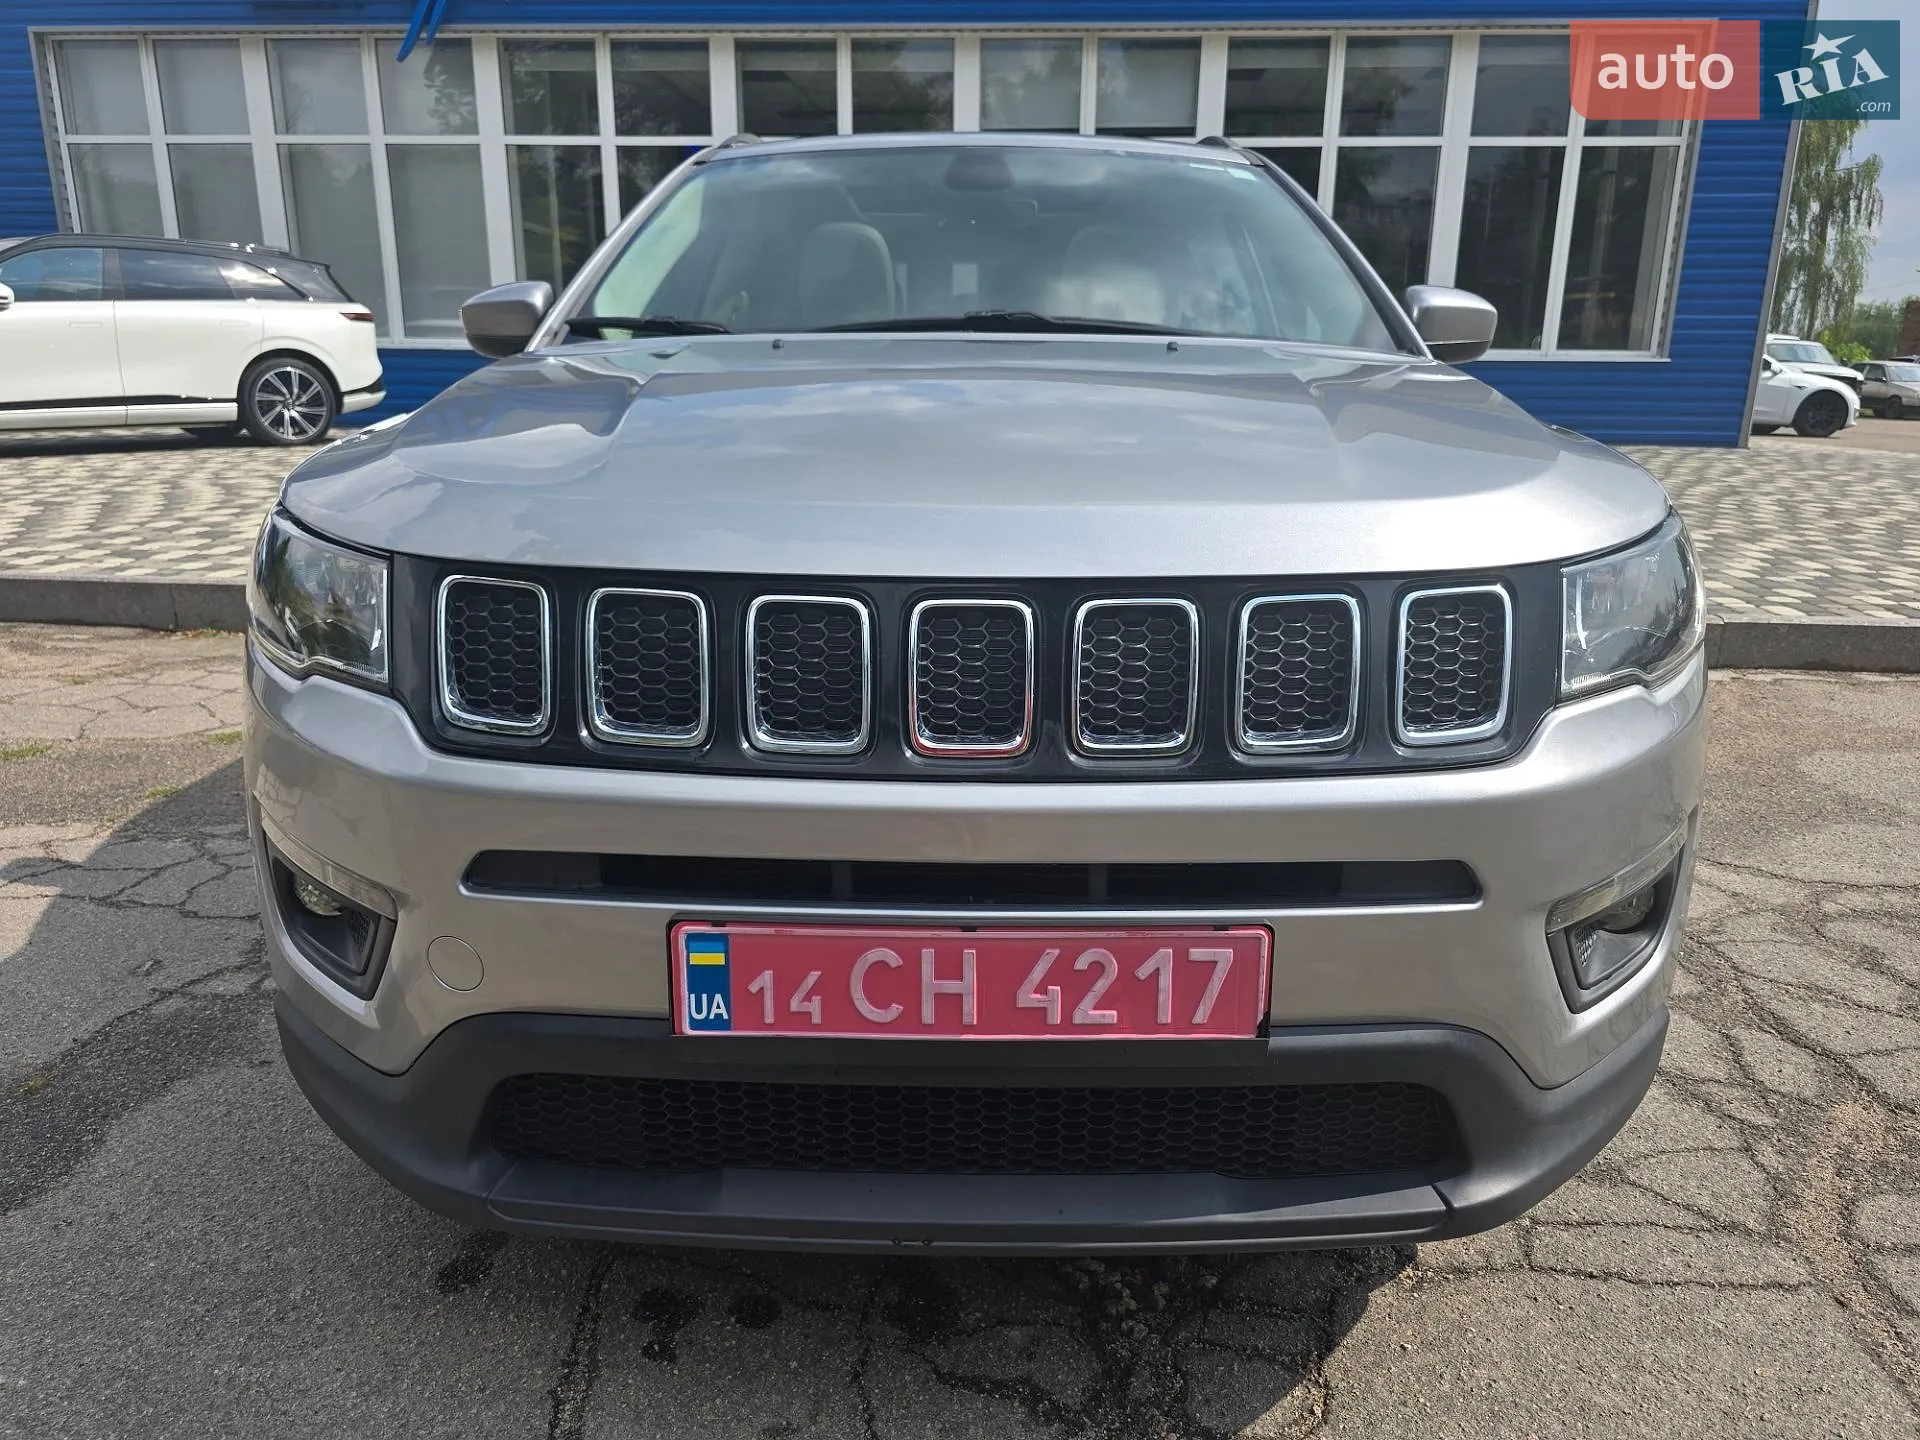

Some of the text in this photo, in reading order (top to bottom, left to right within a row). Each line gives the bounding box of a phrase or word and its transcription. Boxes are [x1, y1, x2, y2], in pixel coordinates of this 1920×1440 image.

[689, 994, 729, 1020] UA
[747, 948, 1233, 1026] 14 CH 4217
